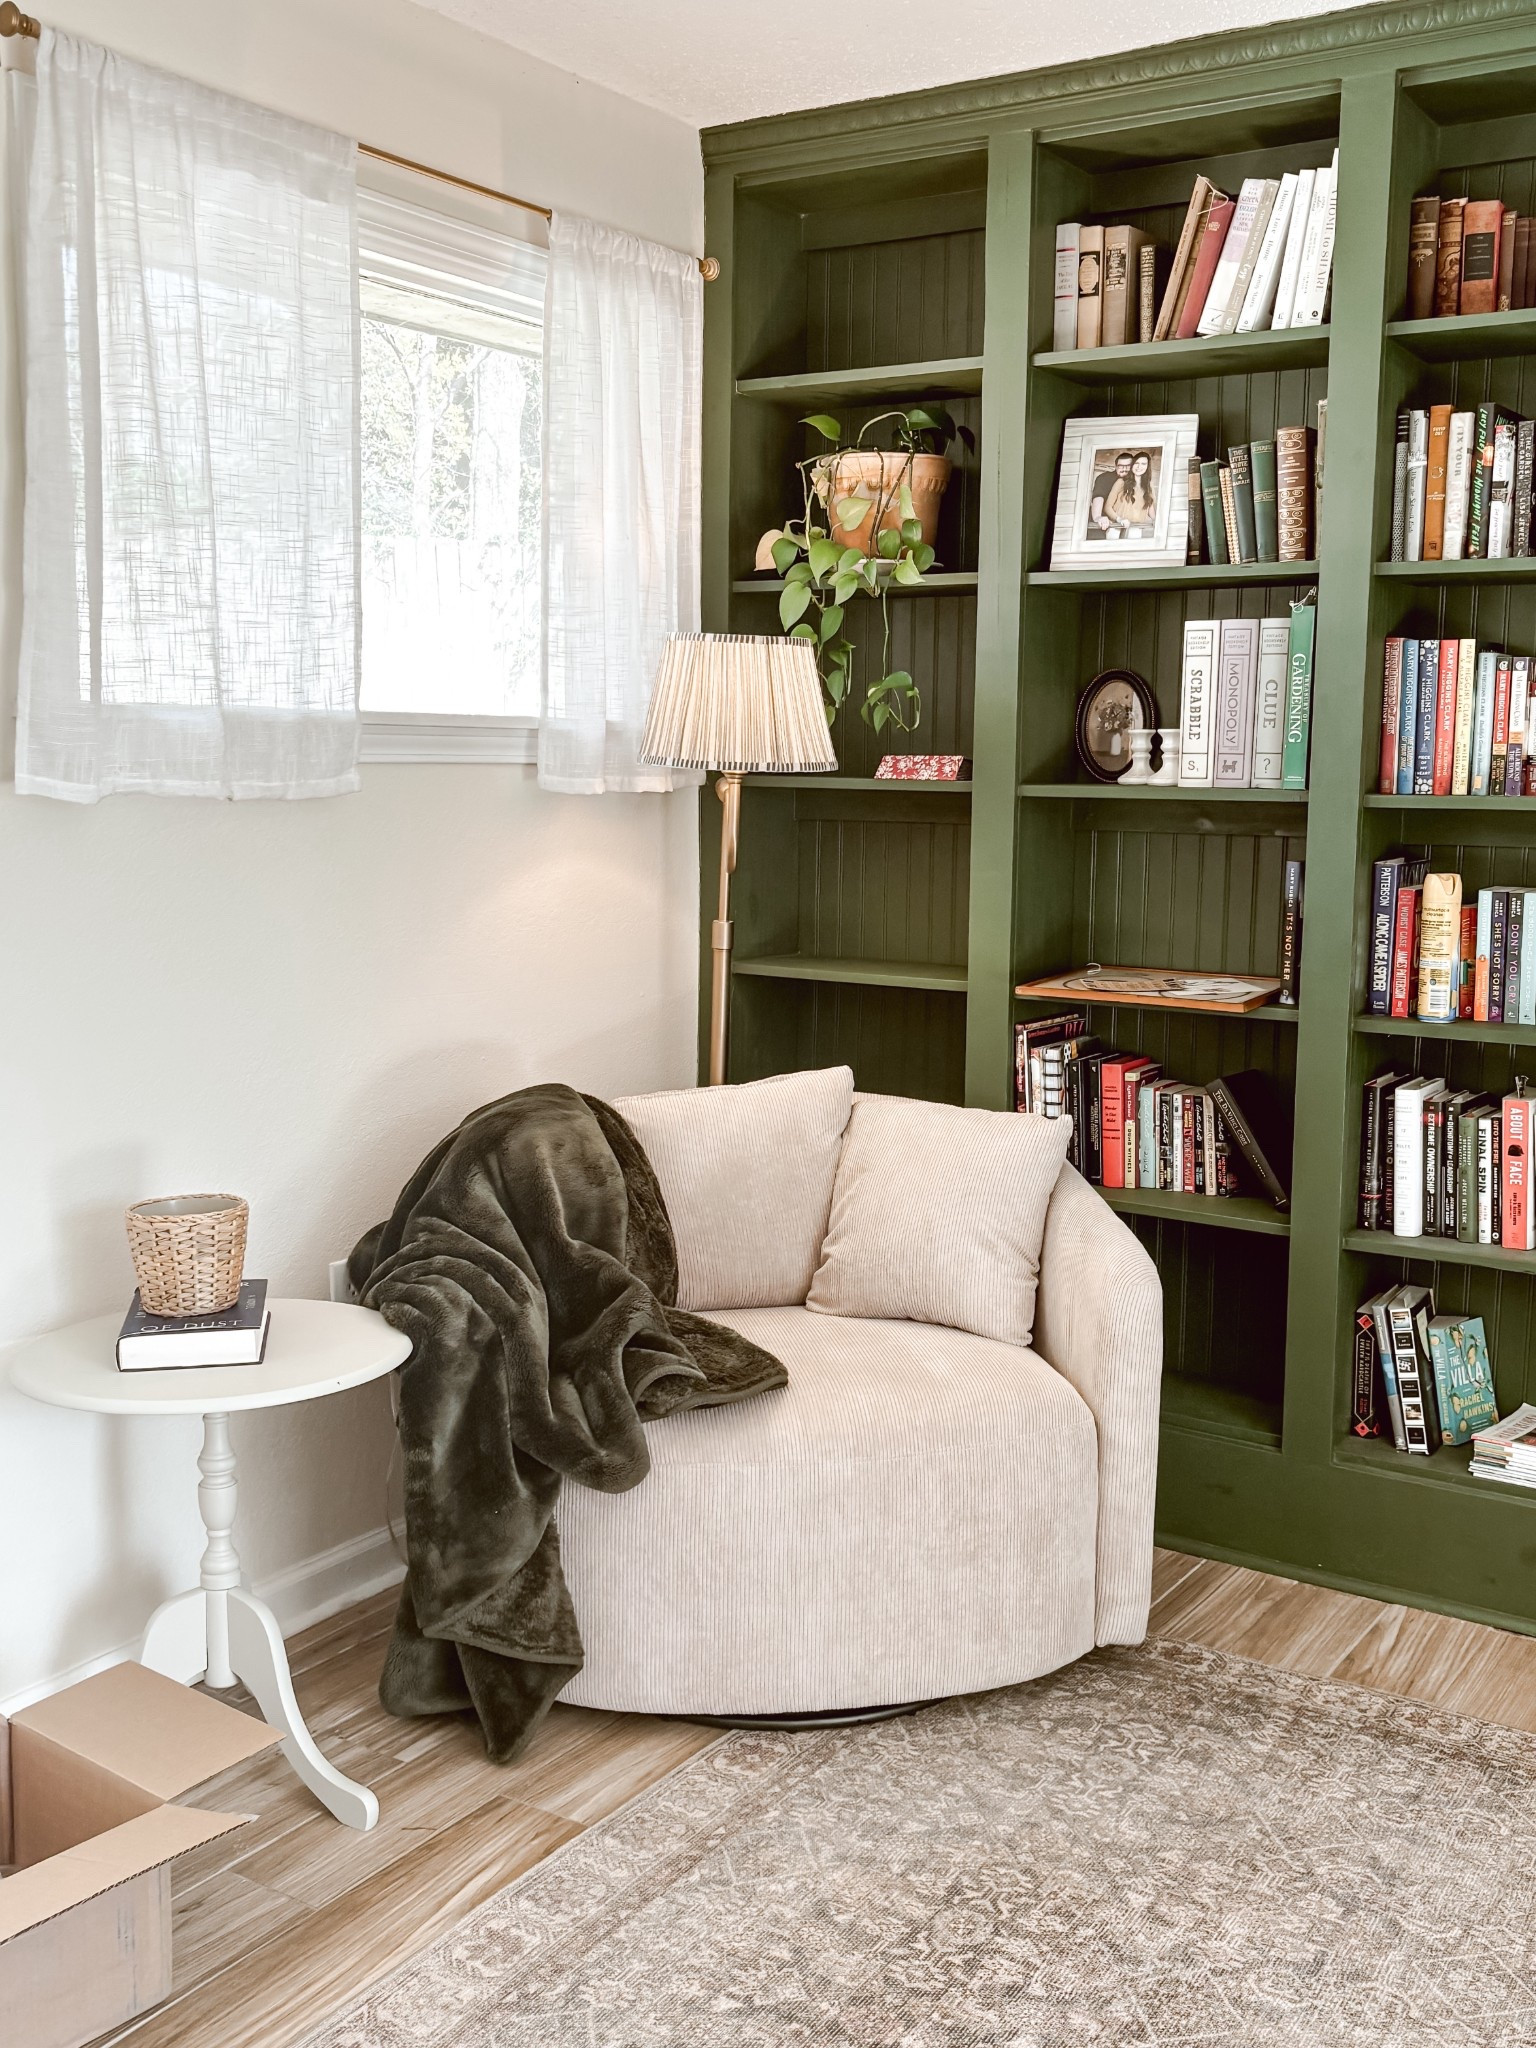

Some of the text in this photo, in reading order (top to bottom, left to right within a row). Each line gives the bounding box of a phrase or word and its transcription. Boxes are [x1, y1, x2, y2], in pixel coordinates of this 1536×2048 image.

[1324, 198, 1337, 235] HOME
[1315, 251, 1328, 293] SHARE
[1477, 408, 1488, 453] LUCY FOLEY
[1230, 455, 1248, 463] LITTLE
[1454, 448, 1464, 476] YOUR
[1524, 452, 1532, 474] GIRLS
[1471, 460, 1484, 551] THE MIDNIGHT FEAST
[1518, 518, 1526, 546] JEWELL
[1465, 644, 1473, 664] MARY
[1287, 653, 1306, 743] GARDENING
[1302, 673, 1310, 723] TREASURY OF
[1404, 647, 1414, 732] MARY HIGGINS CLARK
[1424, 678, 1432, 712] HIGGINS
[1444, 647, 1454, 731] MARY HIGGINS CLARK
[1464, 668, 1472, 700] HIGGINS
[1188, 669, 1203, 740] SCRABBLE
[1225, 662, 1240, 744] MONOPOLY
[1262, 679, 1278, 728] CLUE
[1496, 673, 1507, 742] MARY HIGGINS CLARK
[1423, 714, 1431, 742] CLARK
[1508, 751, 1516, 760] THE
[1380, 867, 1390, 906] PATTERSON
[1286, 912, 1294, 931] IT'S
[1375, 913, 1389, 939] ALONG
[1462, 917, 1470, 945] WARD
[1494, 922, 1502, 948] SHE'S
[1284, 935, 1292, 956] NOT
[1374, 939, 1387, 959] CAME
[1395, 906, 1409, 999] WORST CASE JAMES PATTERSON
[1373, 966, 1386, 991] SPIDER
[1508, 924, 1520, 1005] DON'T YOU CRY
[1162, 1103, 1170, 1123] Agatha
[1214, 1090, 1248, 1146] THE DA VINCI CODE
[1447, 1121, 1455, 1155] DICHOTOMY
[1509, 1107, 1523, 1185] ABOUT FACE
[1426, 1113, 1436, 1194] EXTREME OWNERSHIP
[1478, 1128, 1487, 1194] FINAL SPIN
[1184, 1168, 1192, 1184] WEB
[184, 1320, 243, 1330] DUST
[1437, 1356, 1446, 1380] VILLA
[1450, 1355, 1462, 1366] THE
[1450, 1361, 1487, 1387] VILLA
[1364, 1386, 1369, 1395] OF
[1440, 1383, 1448, 1400] RACHEL
[1459, 1393, 1484, 1408] RACHEL
[1463, 1403, 1495, 1418] HAWKINS
